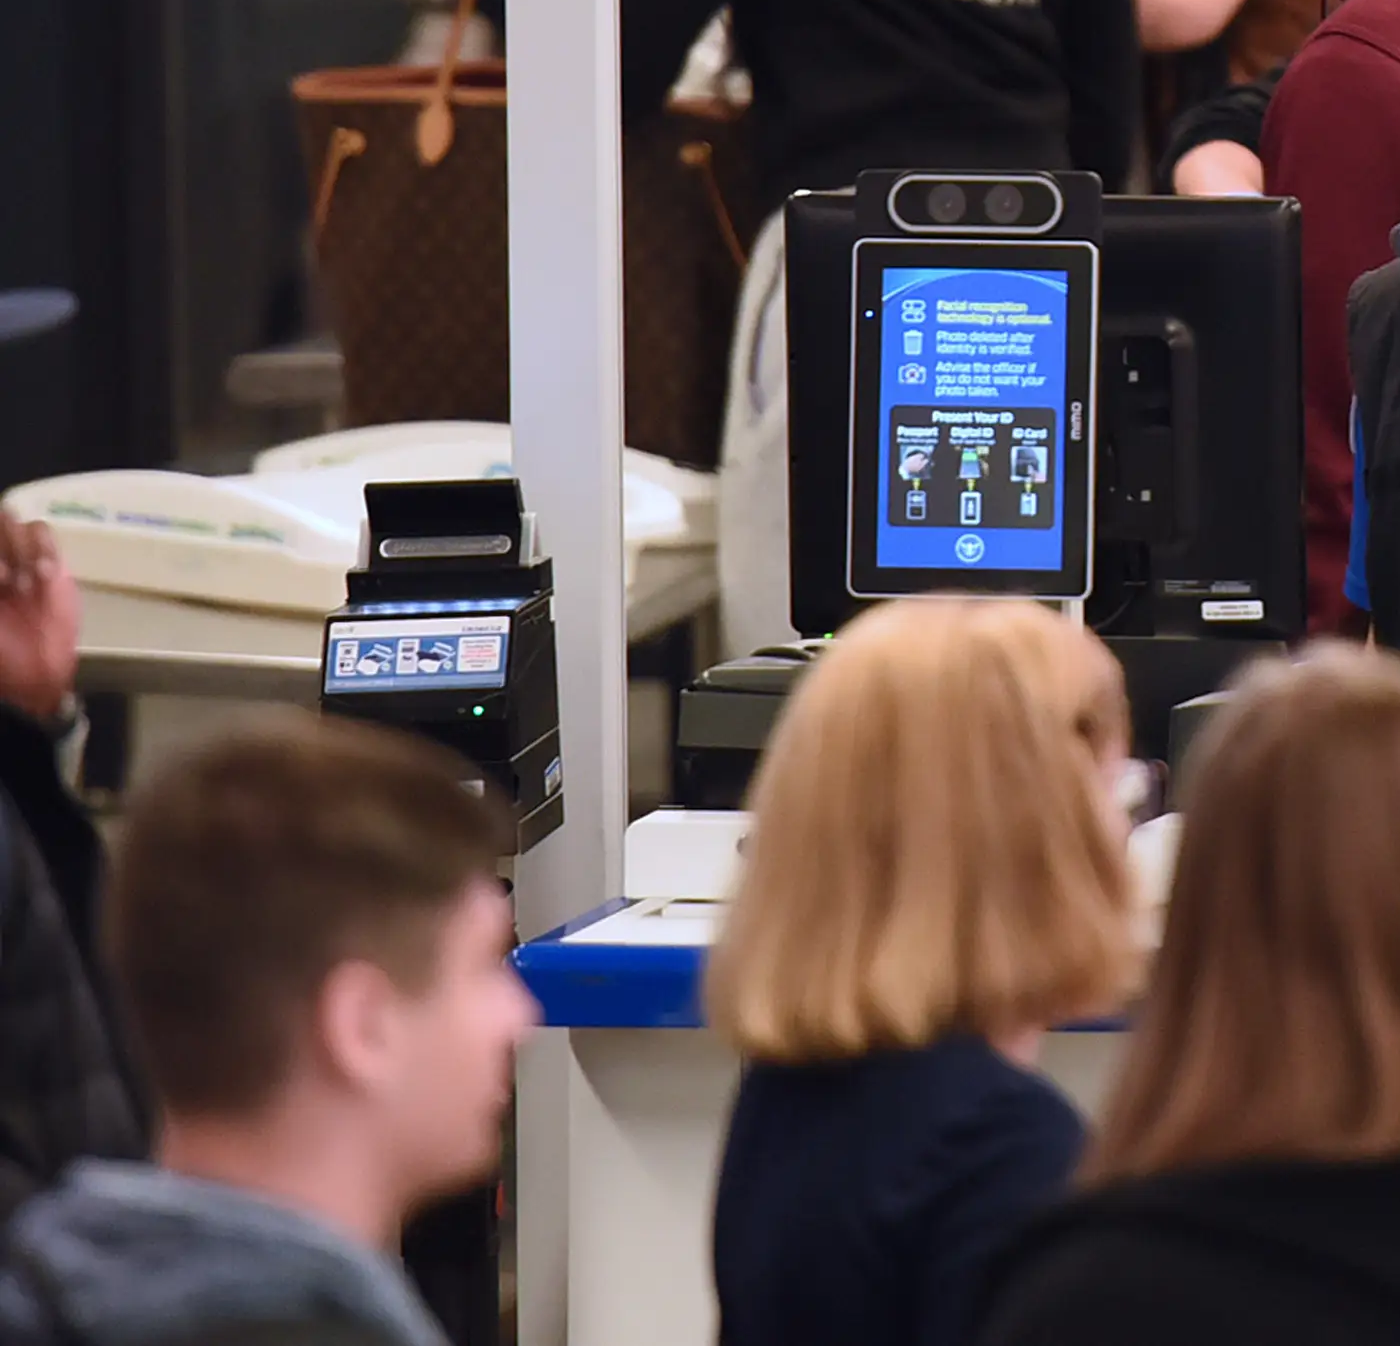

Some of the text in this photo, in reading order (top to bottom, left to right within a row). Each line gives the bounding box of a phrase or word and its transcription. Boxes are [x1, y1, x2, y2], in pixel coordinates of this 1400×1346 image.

[936, 330, 1035, 343] Photo deleted after
[936, 344, 1032, 356] identity is verified.
[936, 361, 971, 373] Advise
[973, 362, 991, 373] the
[992, 362, 1026, 373] officer
[936, 374, 1047, 388] you do not want your
[935, 386, 999, 397] photo taken.
[932, 410, 1014, 424] Present Your ID
[1071, 401, 1082, 441] mimo
[897, 425, 939, 437] Passport
[951, 426, 994, 439] Digital ID
[1012, 428, 1048, 439] ID Card
